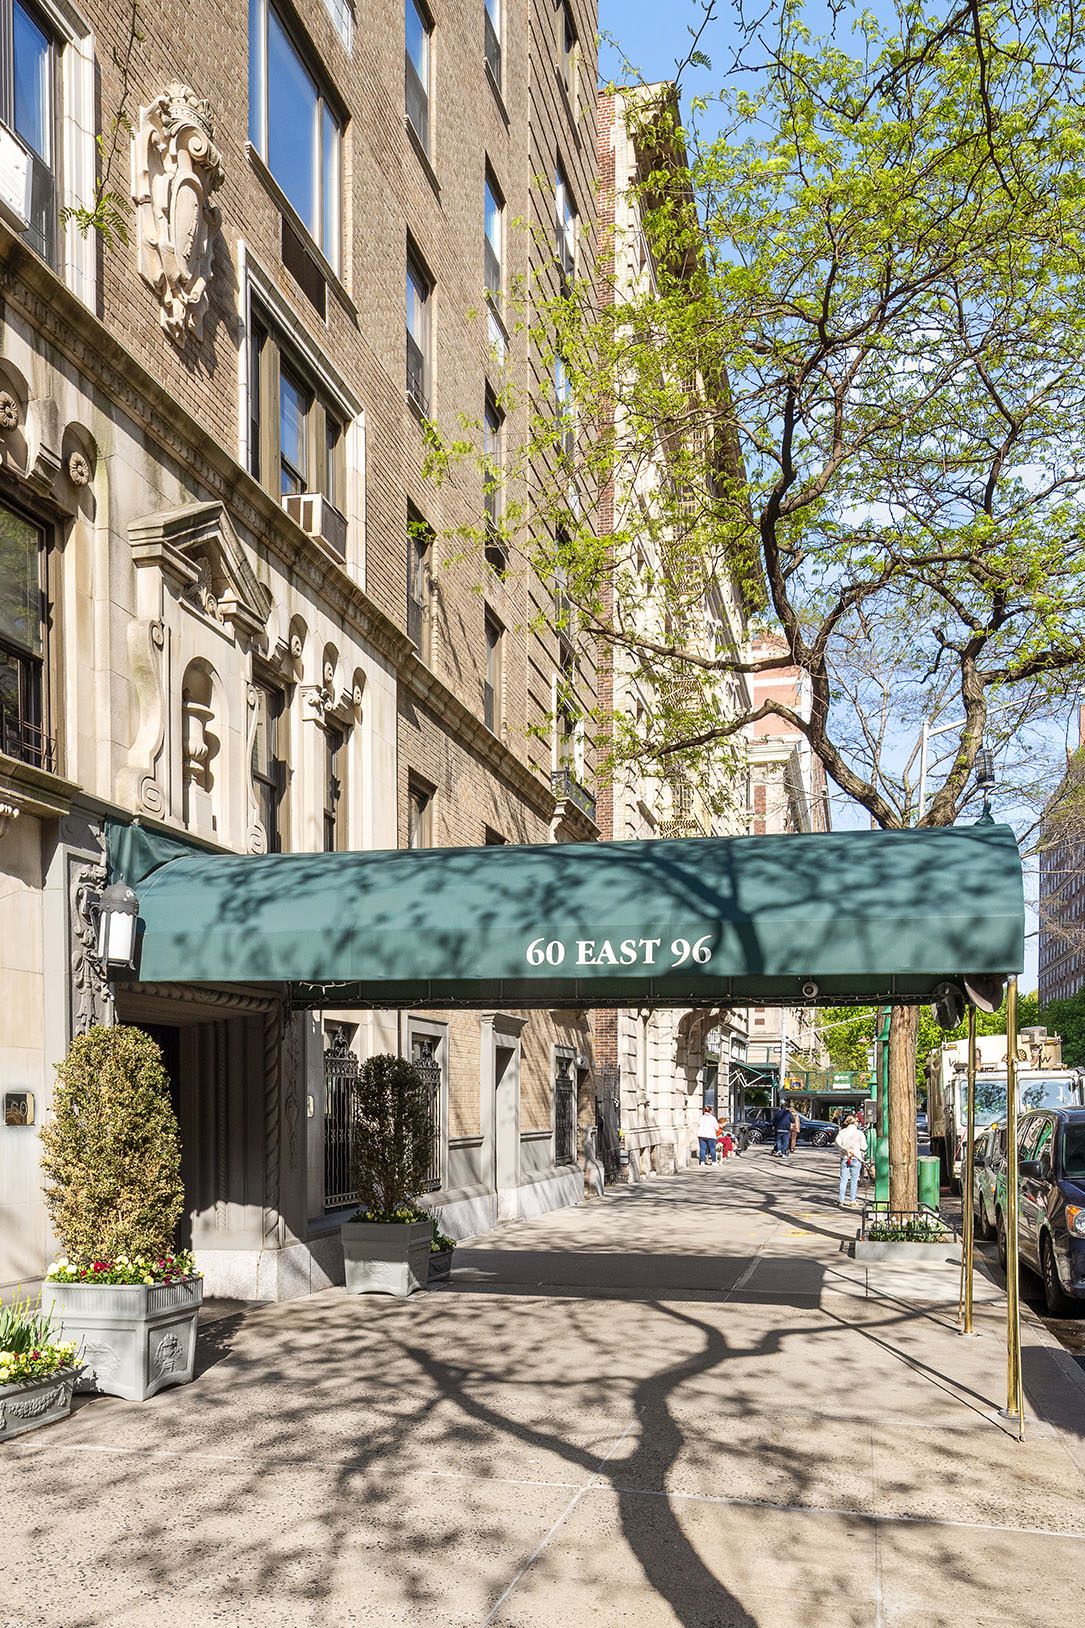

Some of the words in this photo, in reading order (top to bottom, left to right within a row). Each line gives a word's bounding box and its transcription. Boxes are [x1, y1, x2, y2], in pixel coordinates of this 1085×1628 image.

[526, 937, 566, 966] 60
[575, 938, 661, 965] EAST
[671, 934, 712, 967] 96
